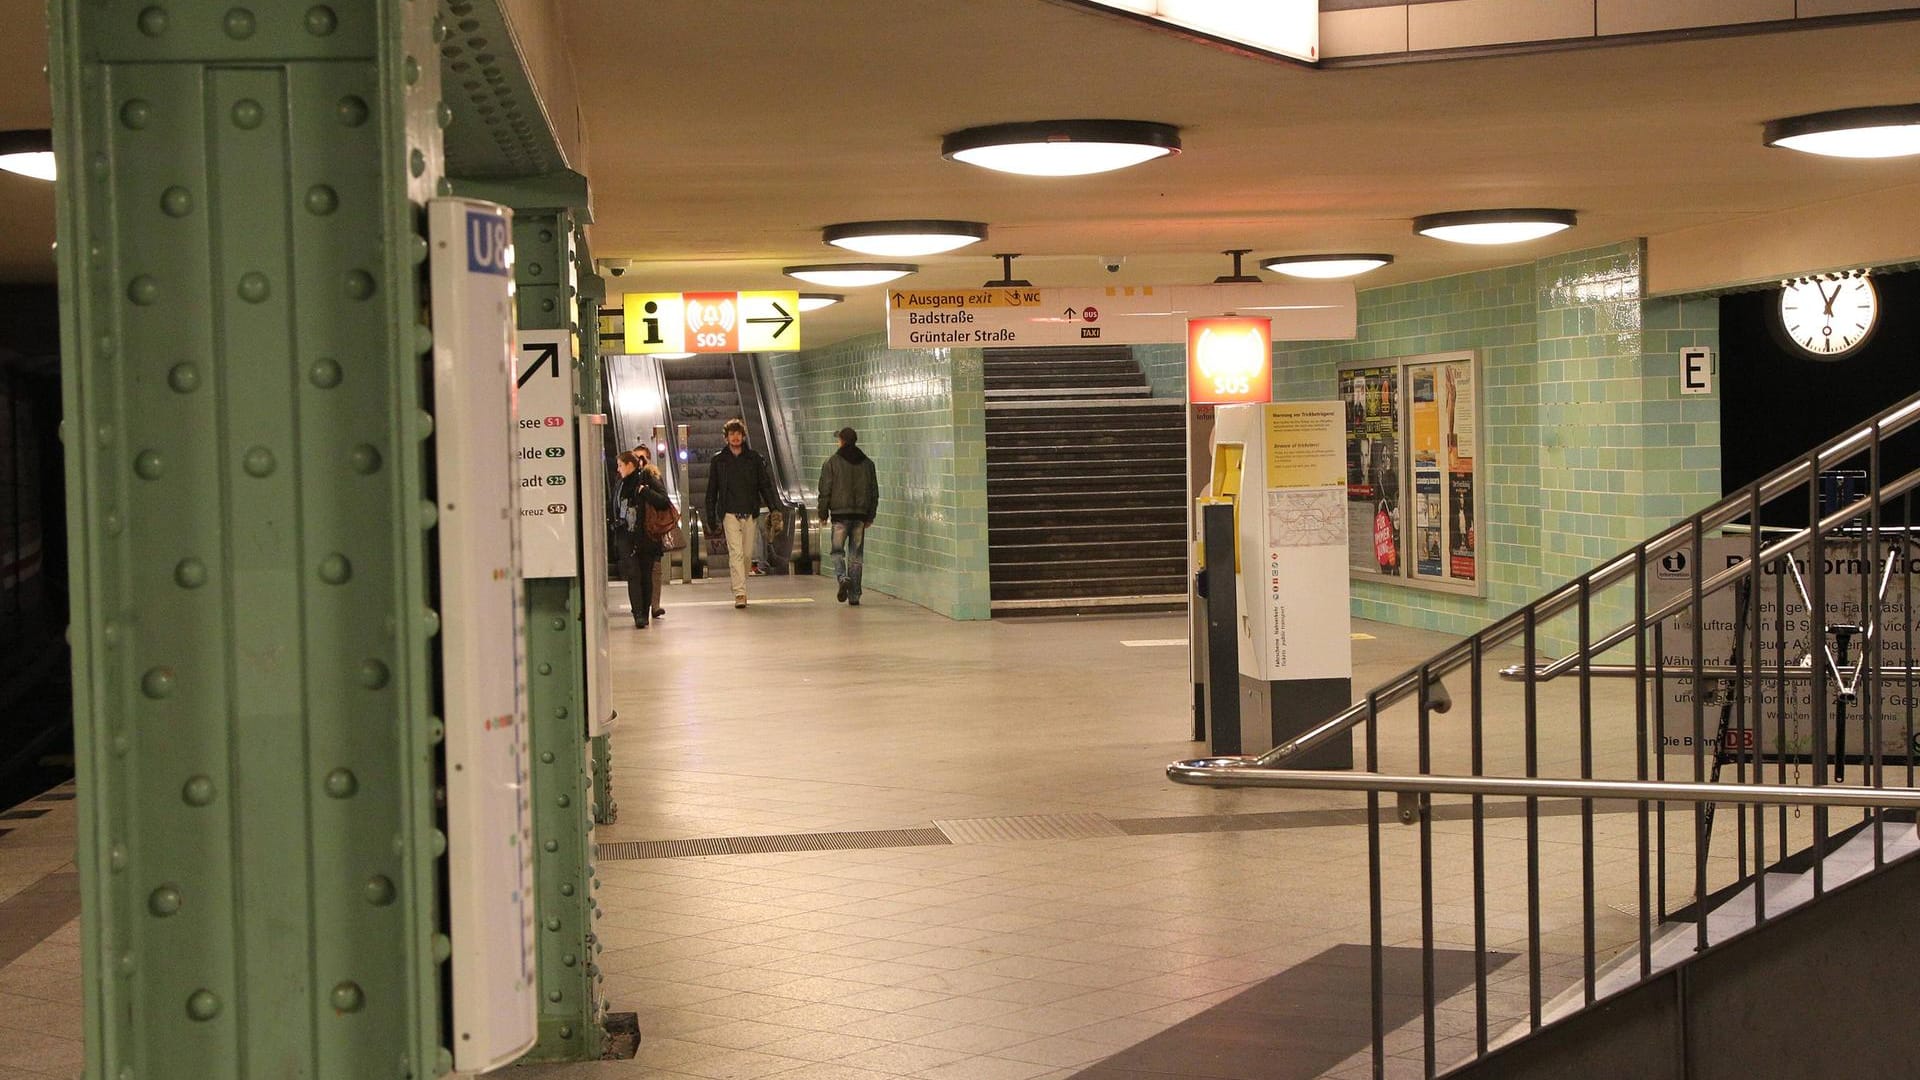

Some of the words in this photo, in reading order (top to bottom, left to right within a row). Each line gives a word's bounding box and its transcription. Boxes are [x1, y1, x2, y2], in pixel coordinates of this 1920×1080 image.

[472, 219, 506, 269] U8
[909, 294, 964, 308] Ausgang
[968, 292, 992, 304] exit
[1024, 293, 1040, 302] WC
[910, 310, 974, 324] Badstraße
[696, 333, 727, 347] SOS
[910, 330, 970, 343] Grüntaler
[974, 329, 1016, 342] Straße
[1686, 352, 1706, 388] E
[1214, 376, 1250, 394] SOS
[520, 419, 541, 429] see
[520, 475, 543, 487] adt
[547, 476, 565, 485] S25
[549, 504, 566, 513] S42
